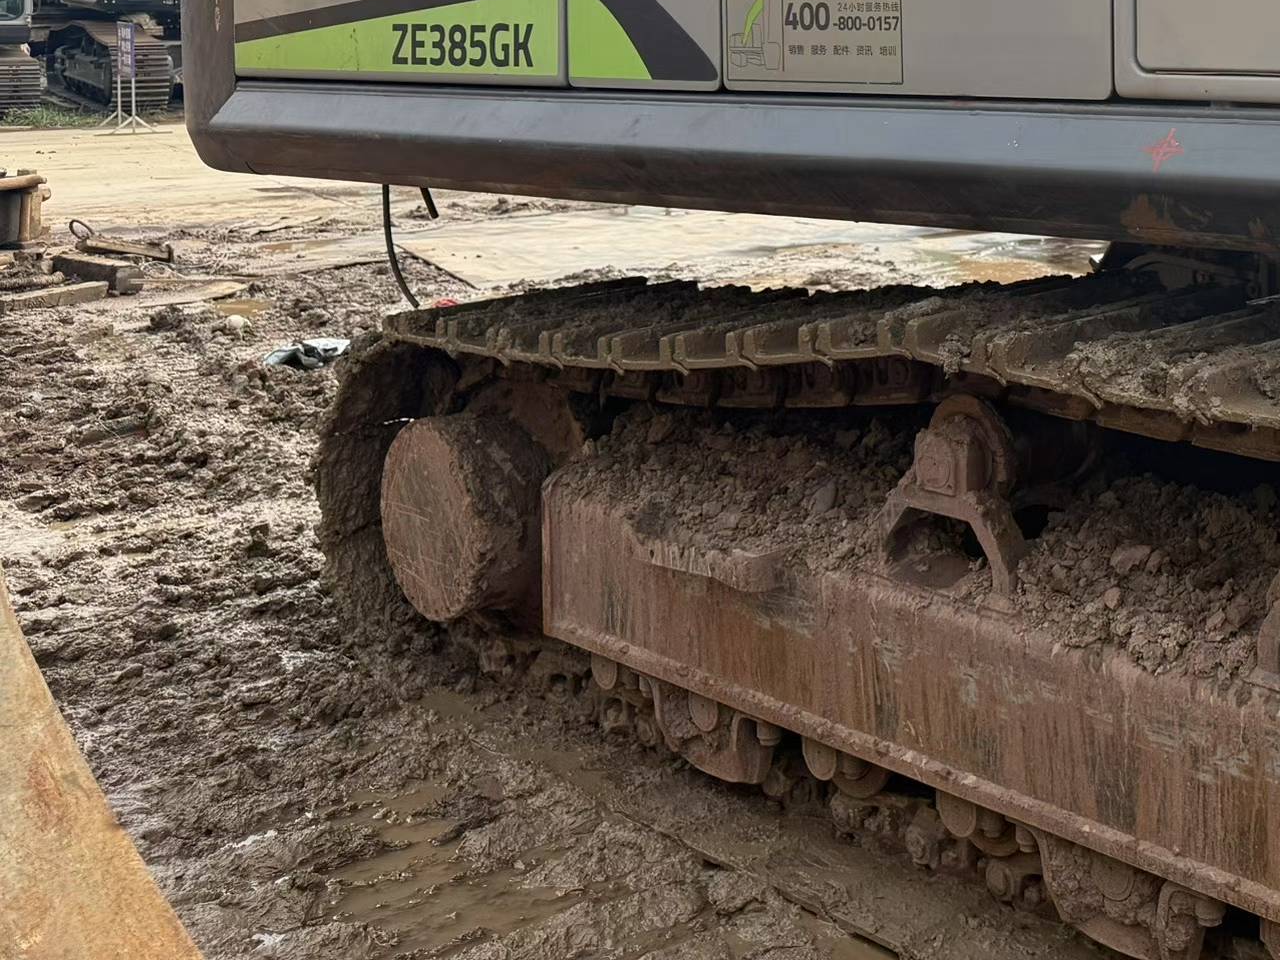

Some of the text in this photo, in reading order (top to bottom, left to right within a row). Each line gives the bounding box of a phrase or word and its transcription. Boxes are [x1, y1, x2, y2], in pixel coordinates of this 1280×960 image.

[392, 23, 534, 67] ZE385GK
[810, 44, 828, 56] 服务
[833, 45, 850, 56] 配件
[879, 45, 897, 57] 培训
